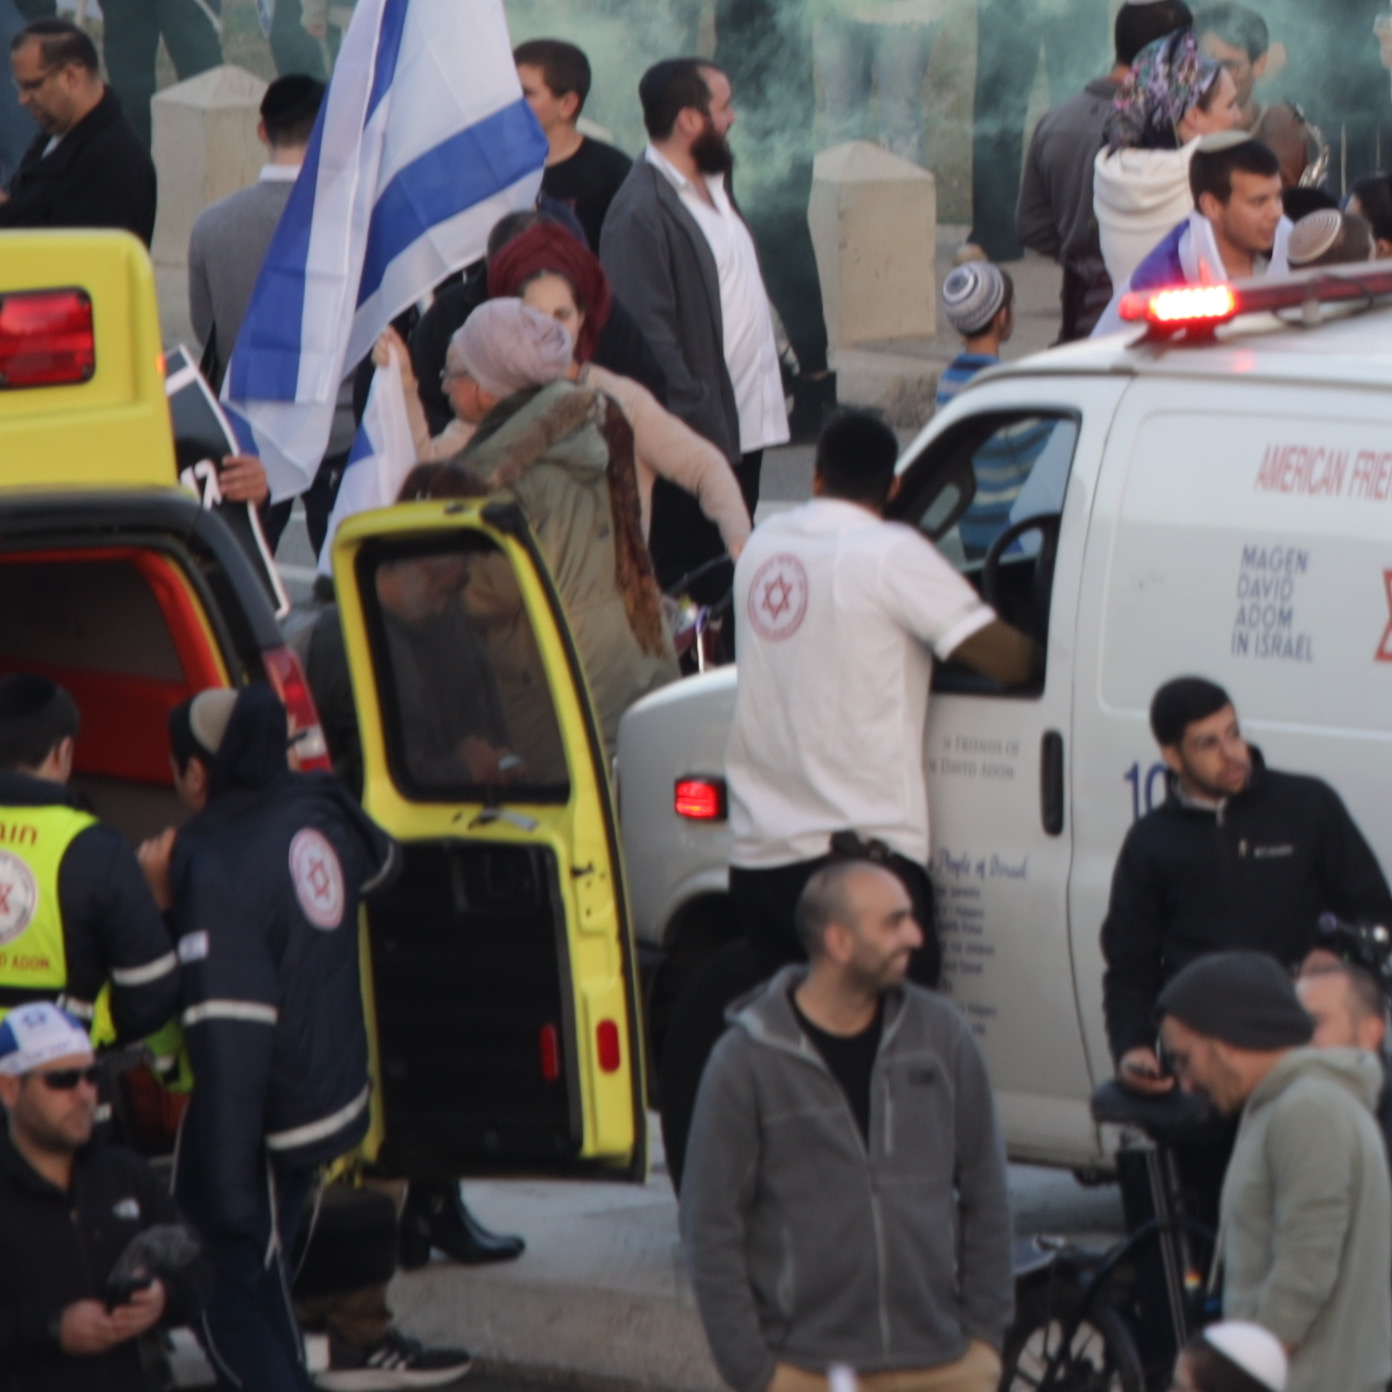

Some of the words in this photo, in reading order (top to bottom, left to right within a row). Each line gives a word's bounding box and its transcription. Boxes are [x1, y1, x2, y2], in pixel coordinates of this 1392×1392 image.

[1254, 443, 1349, 497] AMERICAN
[1240, 543, 1309, 576] MAGEN
[1236, 572, 1294, 603] DAVID
[1234, 603, 1294, 630] ADOM
[1230, 629, 1249, 657] IN
[1253, 631, 1314, 663] ISRAEL
